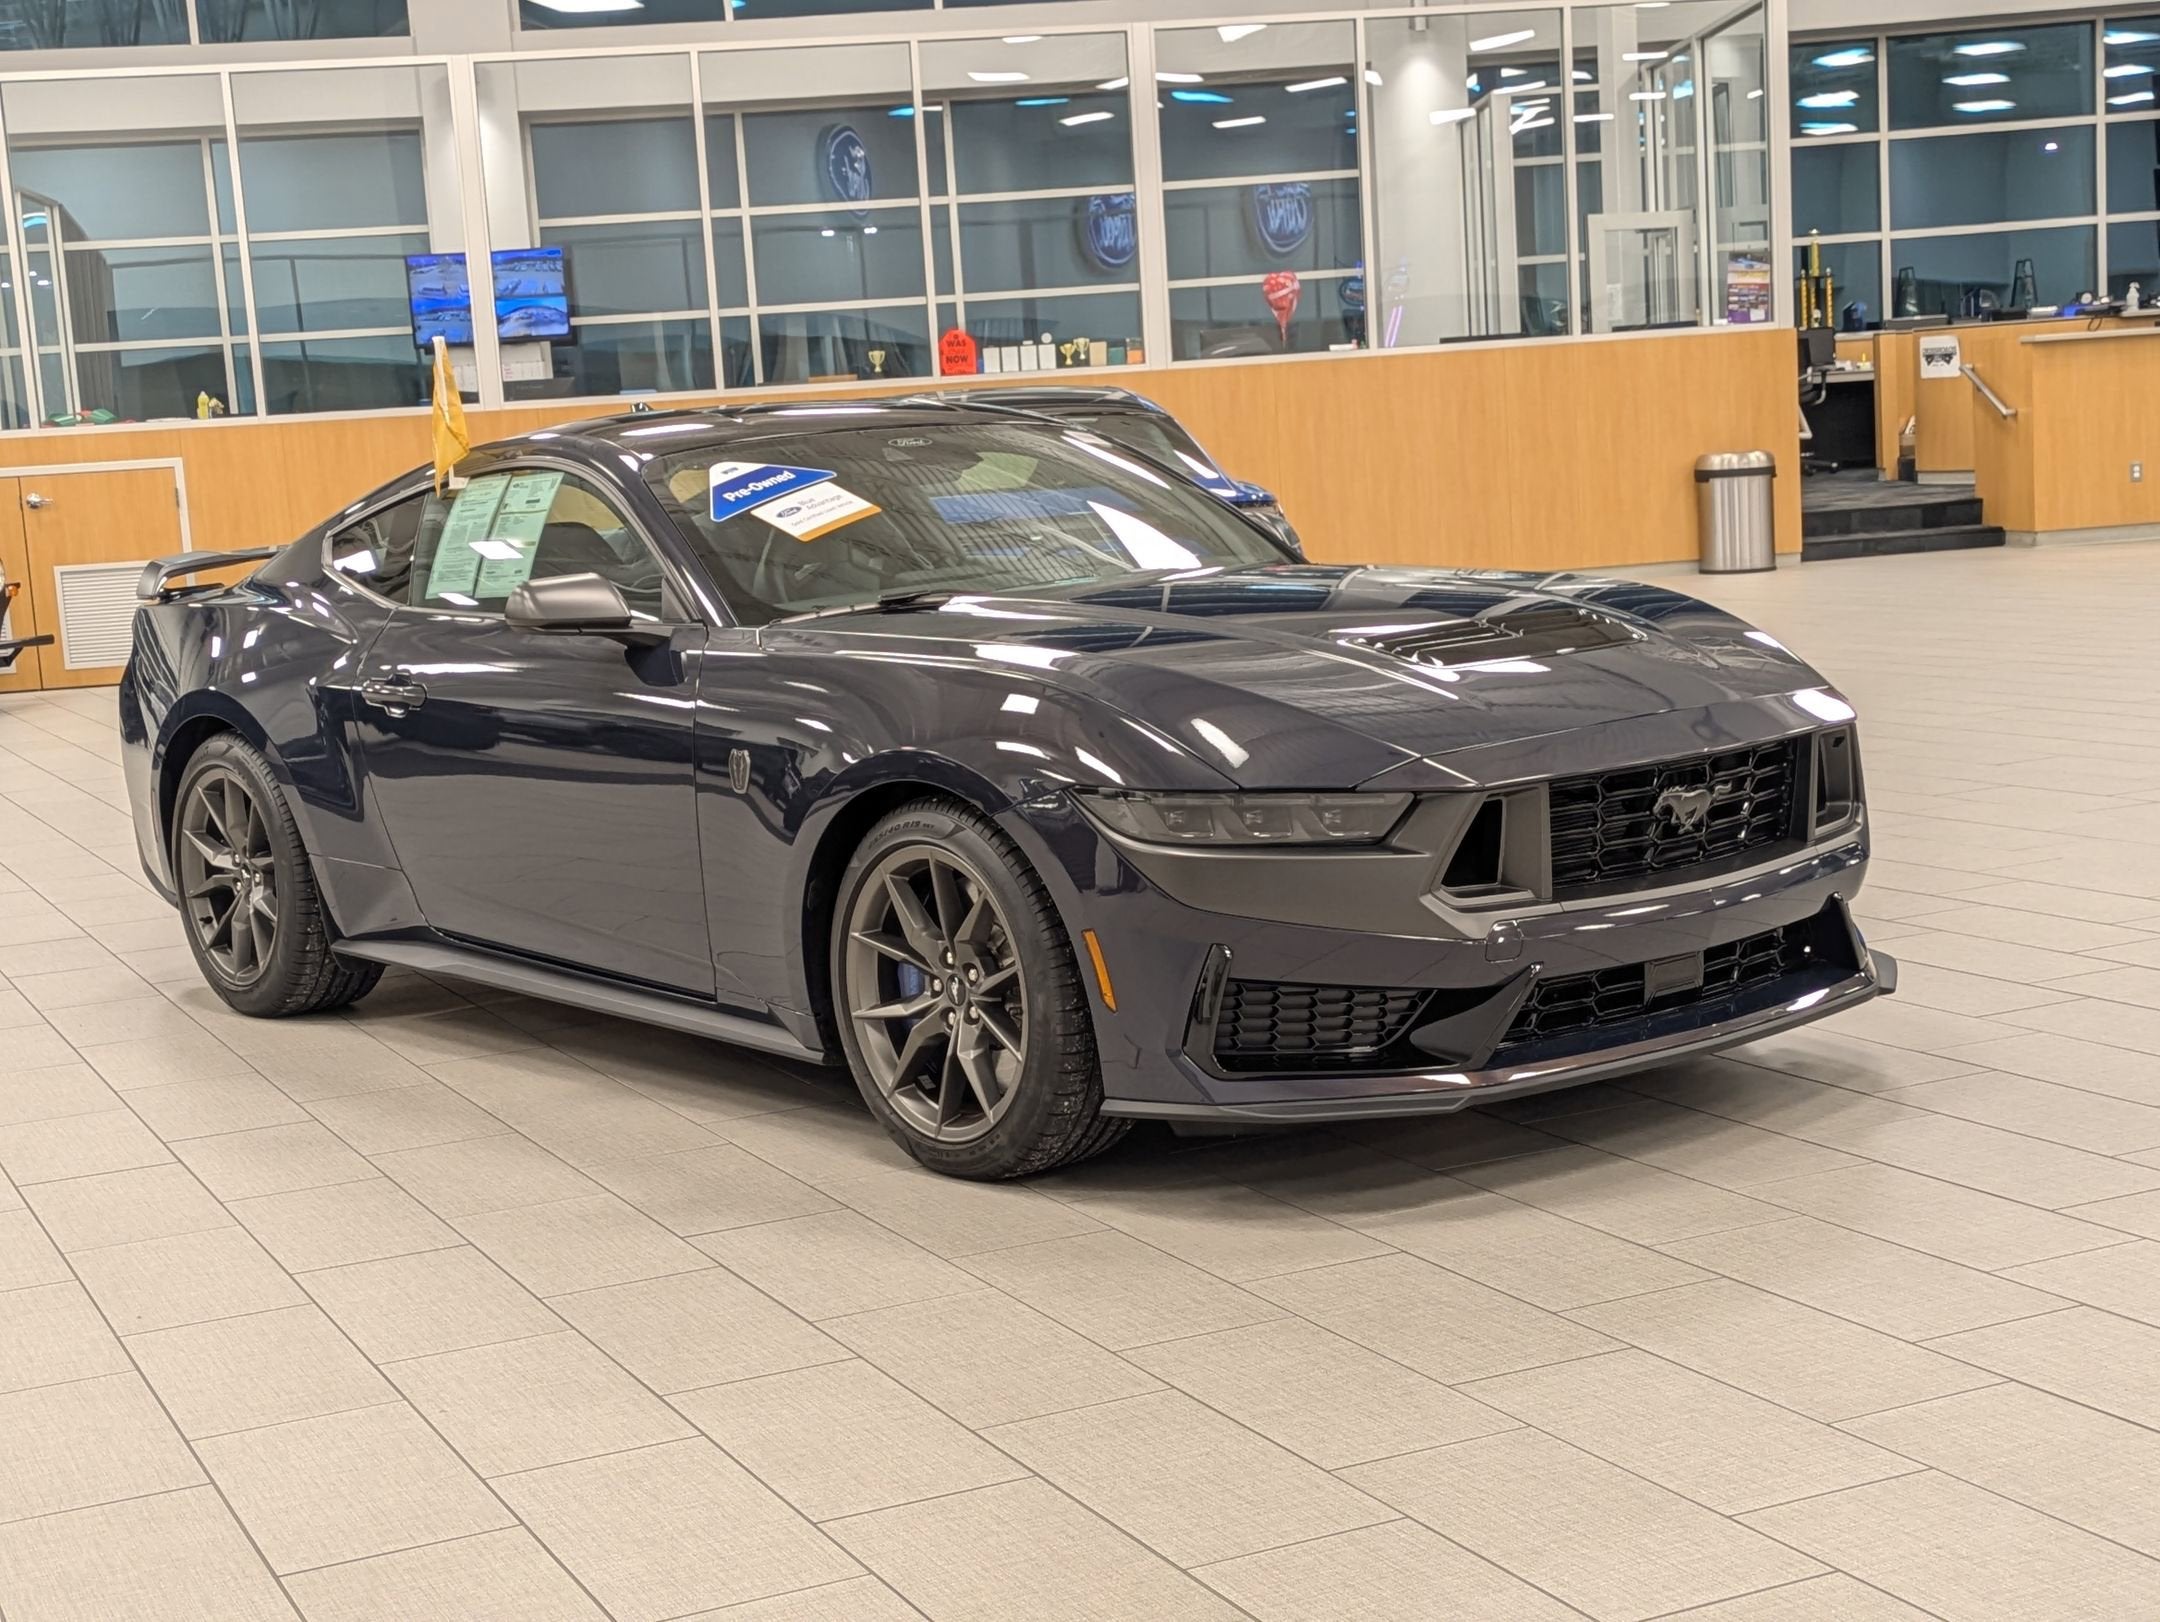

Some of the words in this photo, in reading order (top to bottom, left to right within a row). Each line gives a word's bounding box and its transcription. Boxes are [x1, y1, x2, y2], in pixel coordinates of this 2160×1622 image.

[946, 339, 966, 347] WAS
[945, 354, 968, 364] NOW
[723, 470, 796, 501] Pre-Owned
